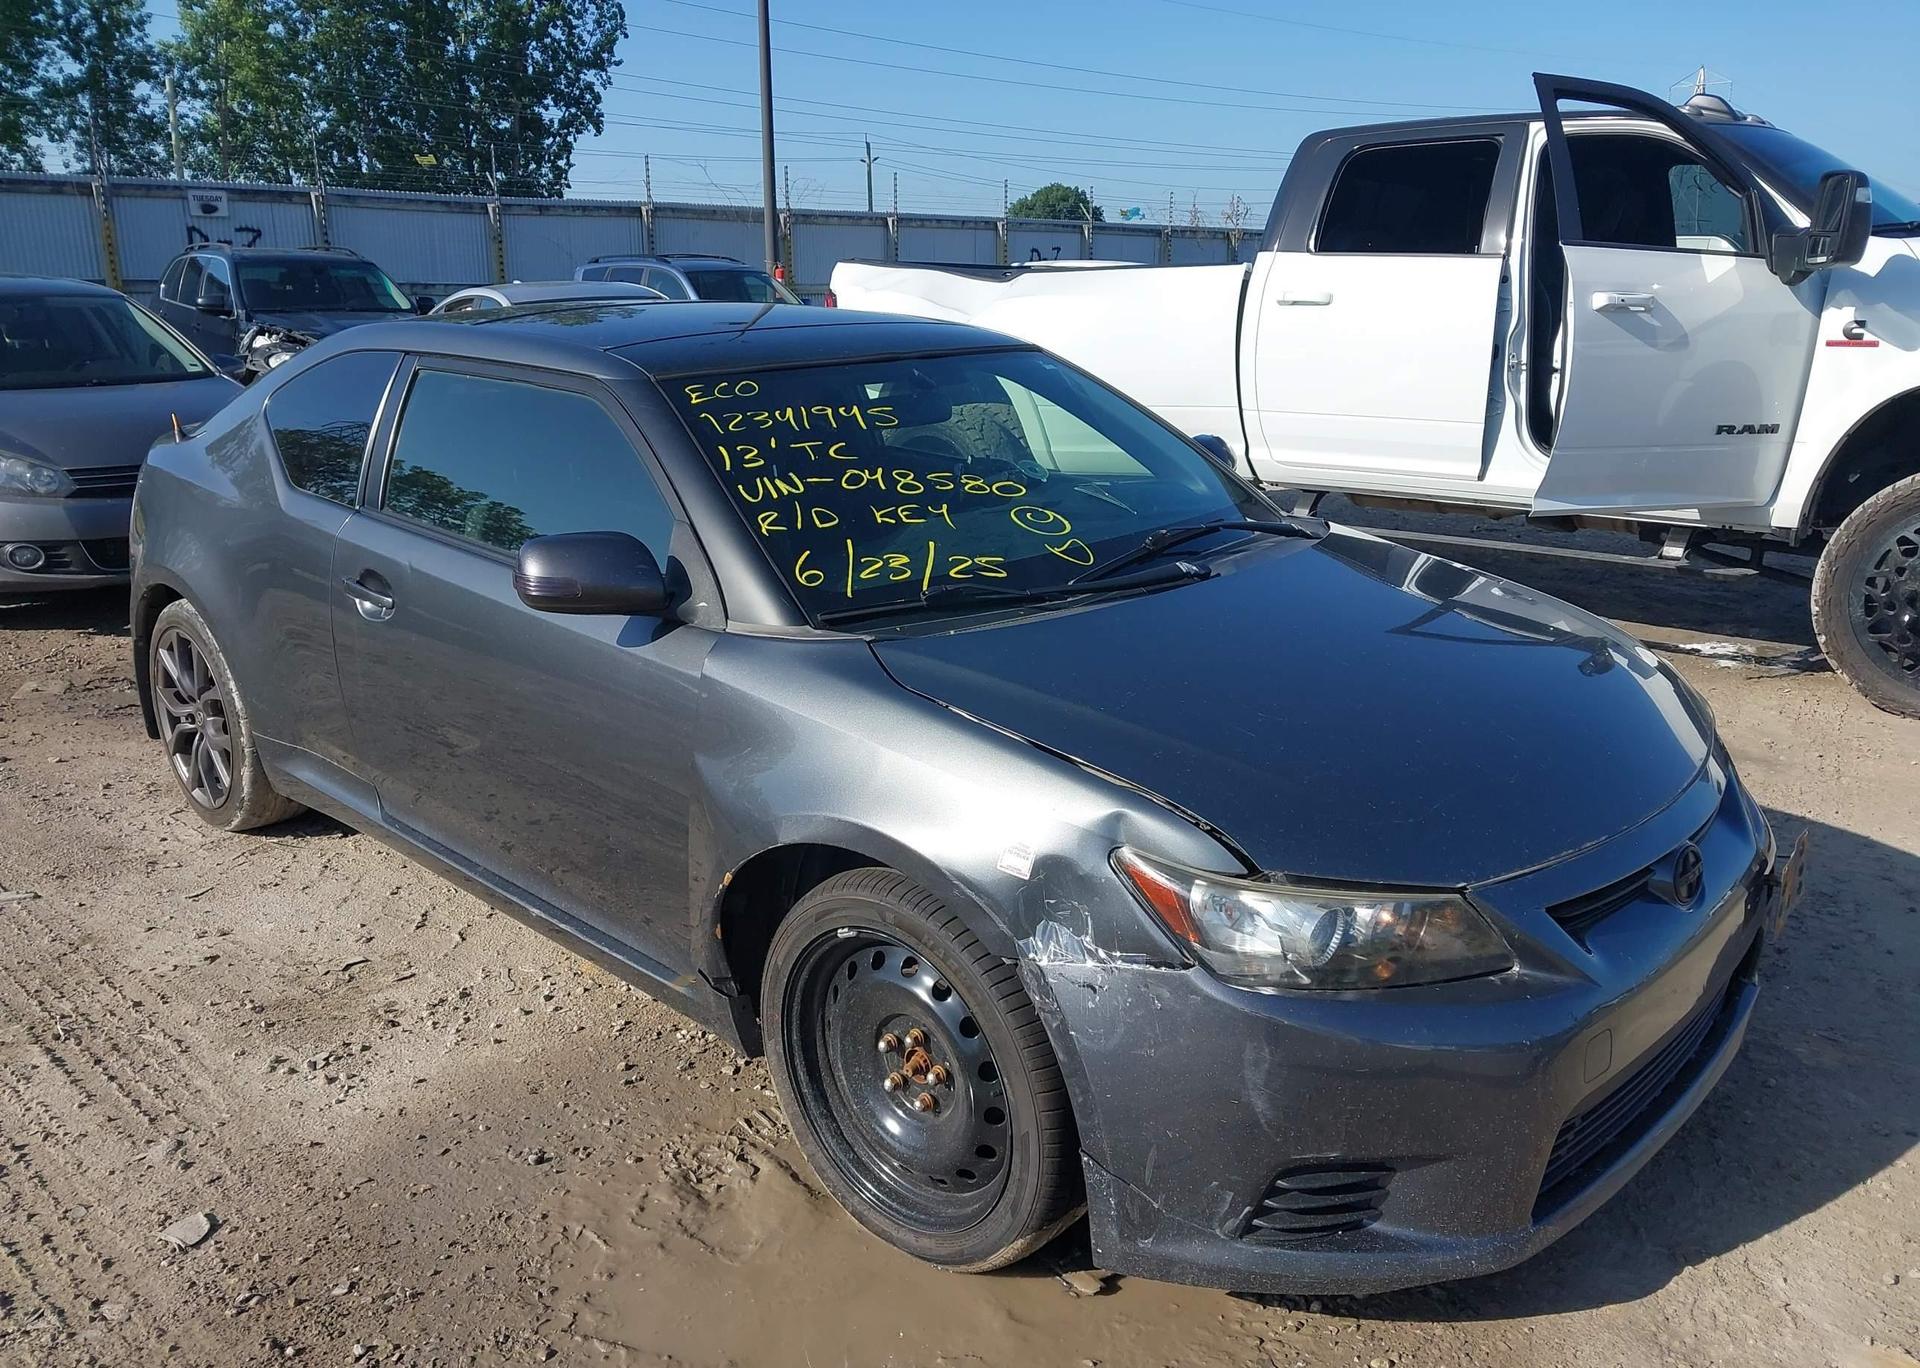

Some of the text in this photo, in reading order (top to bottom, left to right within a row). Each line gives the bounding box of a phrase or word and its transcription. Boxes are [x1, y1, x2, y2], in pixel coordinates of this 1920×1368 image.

[192, 194, 223, 202] TUESDAY
[685, 380, 759, 404] ECO
[1715, 423, 1780, 435] RAM
[870, 503, 957, 530] KEY
